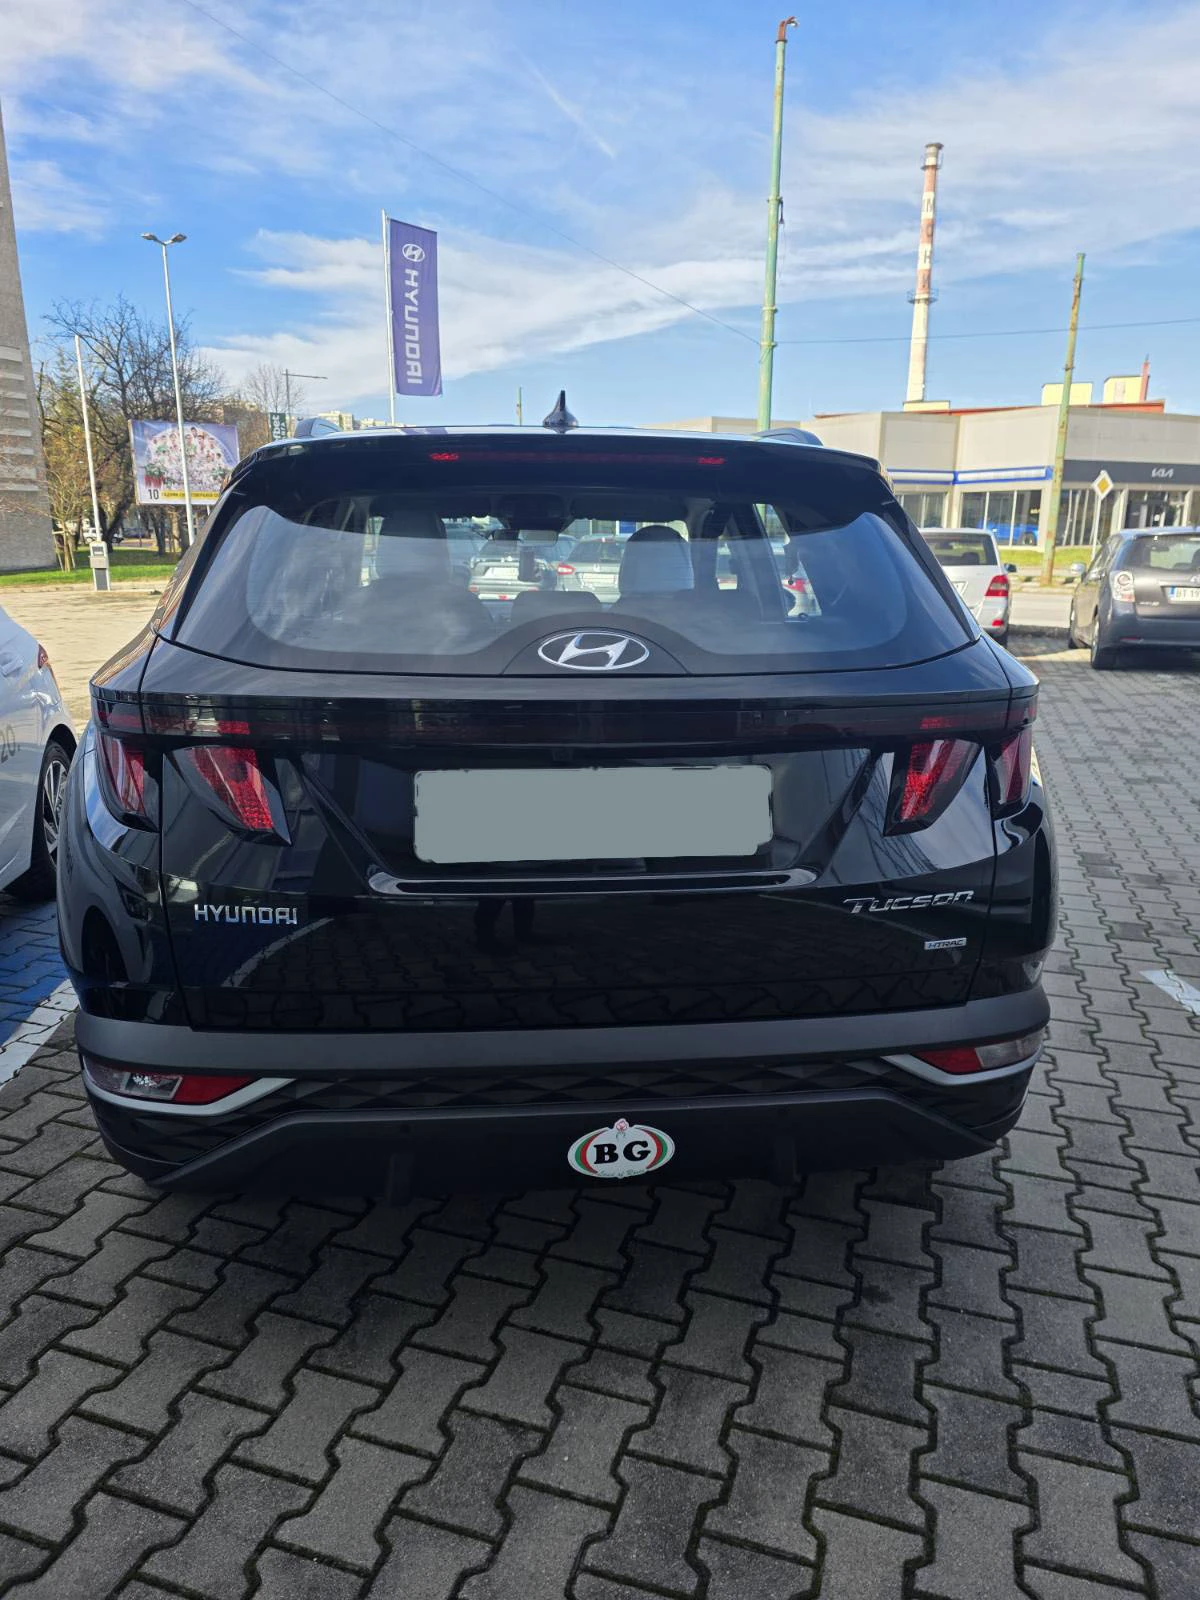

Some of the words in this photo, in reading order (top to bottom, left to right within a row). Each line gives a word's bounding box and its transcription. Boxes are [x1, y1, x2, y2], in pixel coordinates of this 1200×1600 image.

[404, 268, 423, 384] HYUNDAI
[148, 489, 160, 500] 10
[194, 903, 298, 925] HYUNDAI
[843, 890, 975, 914] TUCSON
[593, 1140, 652, 1165] BG
